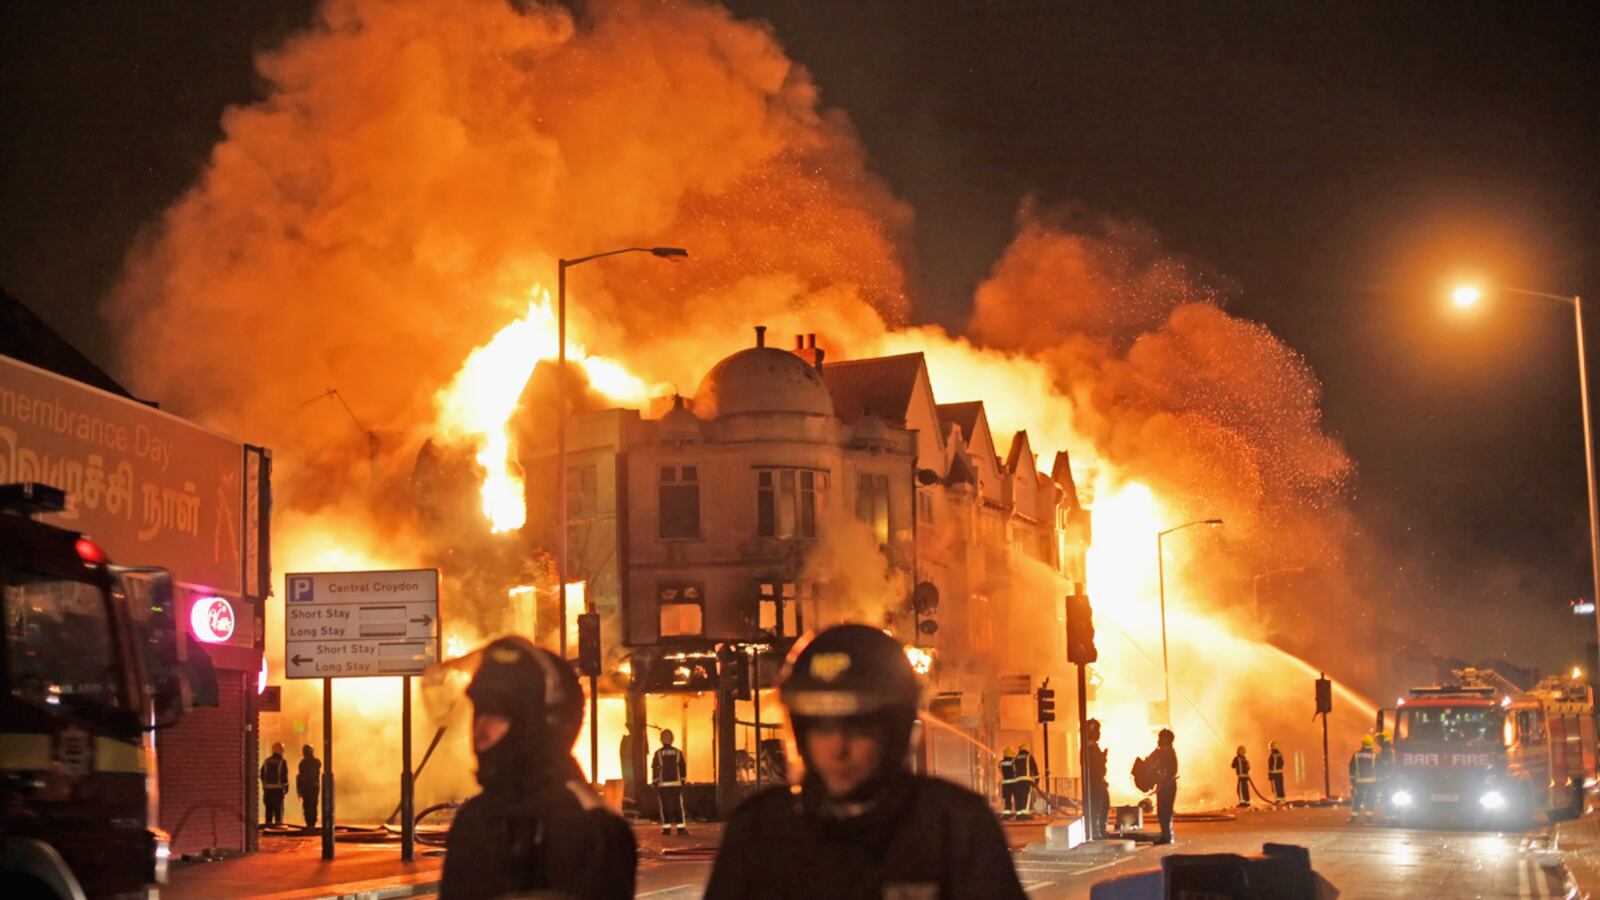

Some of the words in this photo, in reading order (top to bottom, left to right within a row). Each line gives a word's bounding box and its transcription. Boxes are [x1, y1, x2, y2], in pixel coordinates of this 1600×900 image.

[136, 424, 172, 471] Day
[294, 579, 310, 600] P
[328, 583, 369, 593] Central
[372, 582, 419, 592] Croydon
[291, 609, 322, 619] Short
[326, 608, 350, 619] Stay
[290, 627, 317, 637] Long
[321, 626, 345, 636] Stay
[316, 645, 347, 655] Short
[351, 644, 376, 655] Stay
[315, 663, 342, 673] Long
[346, 662, 370, 672] Stay
[1453, 753, 1489, 766] FIRE
